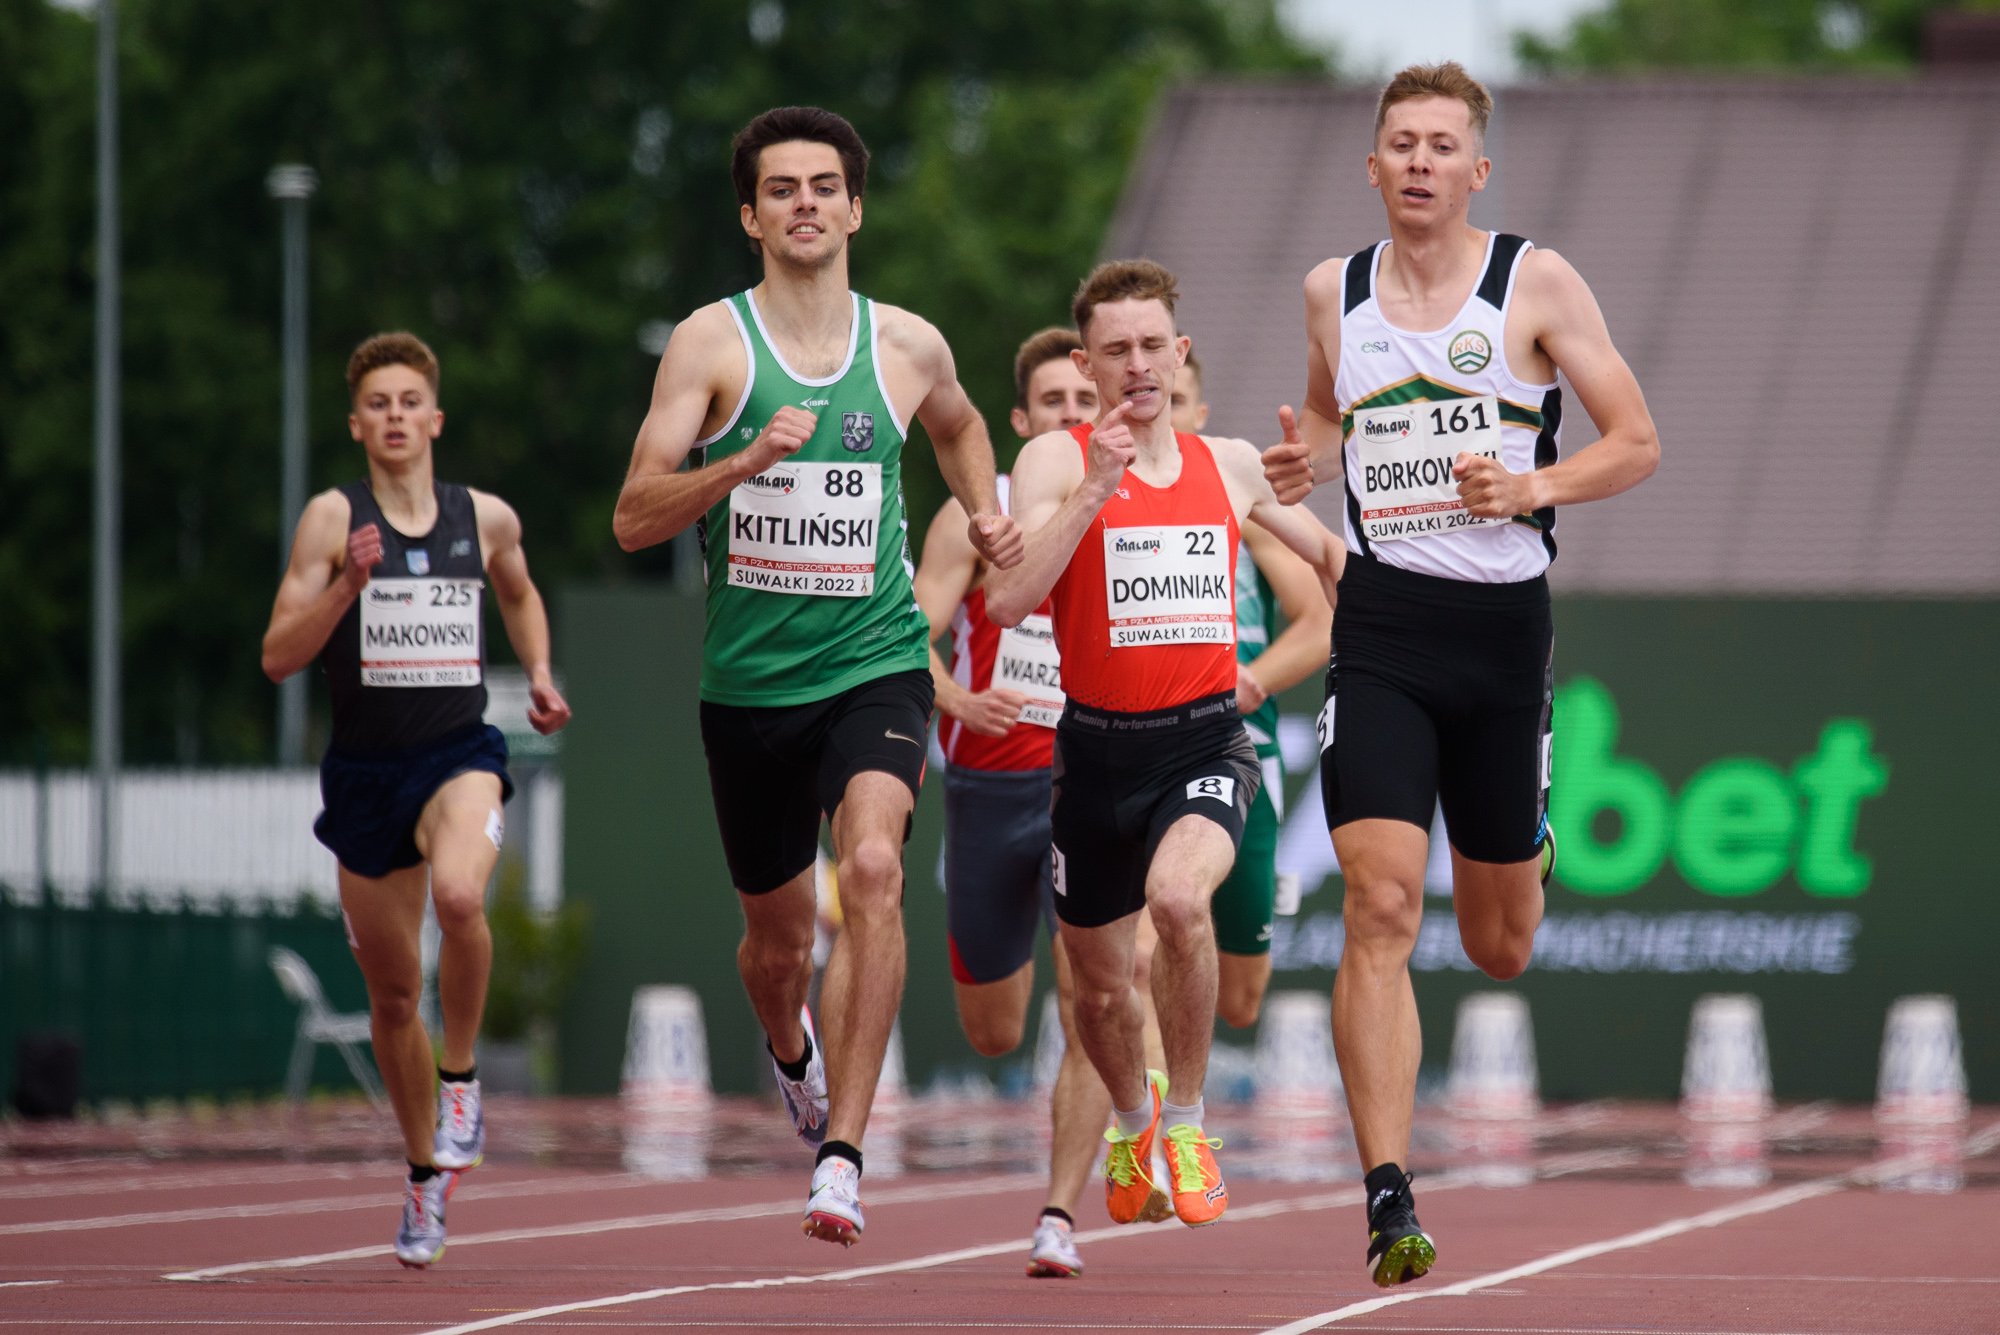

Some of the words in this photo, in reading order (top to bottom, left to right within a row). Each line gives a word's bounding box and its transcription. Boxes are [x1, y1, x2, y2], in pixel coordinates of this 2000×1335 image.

[1361, 341, 1389, 353] esa
[1455, 336, 1485, 355] RKS
[1430, 402, 1490, 436] 161
[824, 469, 864, 498] 88
[1382, 508, 1404, 517] PZLA
[735, 512, 873, 547] KITLIŃSKI
[1370, 517, 1441, 538] SUWAŁKI
[1185, 531, 1215, 555] 22
[734, 556, 749, 566] 98.
[750, 558, 773, 569] PZLA
[775, 562, 843, 573] MISTRZOSTWA
[844, 565, 872, 573] POLSKI
[736, 569, 808, 590] SUWAŁKI
[814, 577, 855, 591] 2022
[1112, 574, 1227, 604] DOMINIAK
[429, 584, 472, 607] 225
[1130, 617, 1153, 626] PZLA
[366, 623, 474, 647] MAKOWSKI
[1118, 627, 1185, 643] SUWAŁKI
[1190, 626, 1217, 639] 2022
[1073, 710, 1108, 730] Running
[1112, 715, 1179, 730] Performance
[1189, 702, 1225, 720] Running
[1198, 778, 1223, 796] 8
